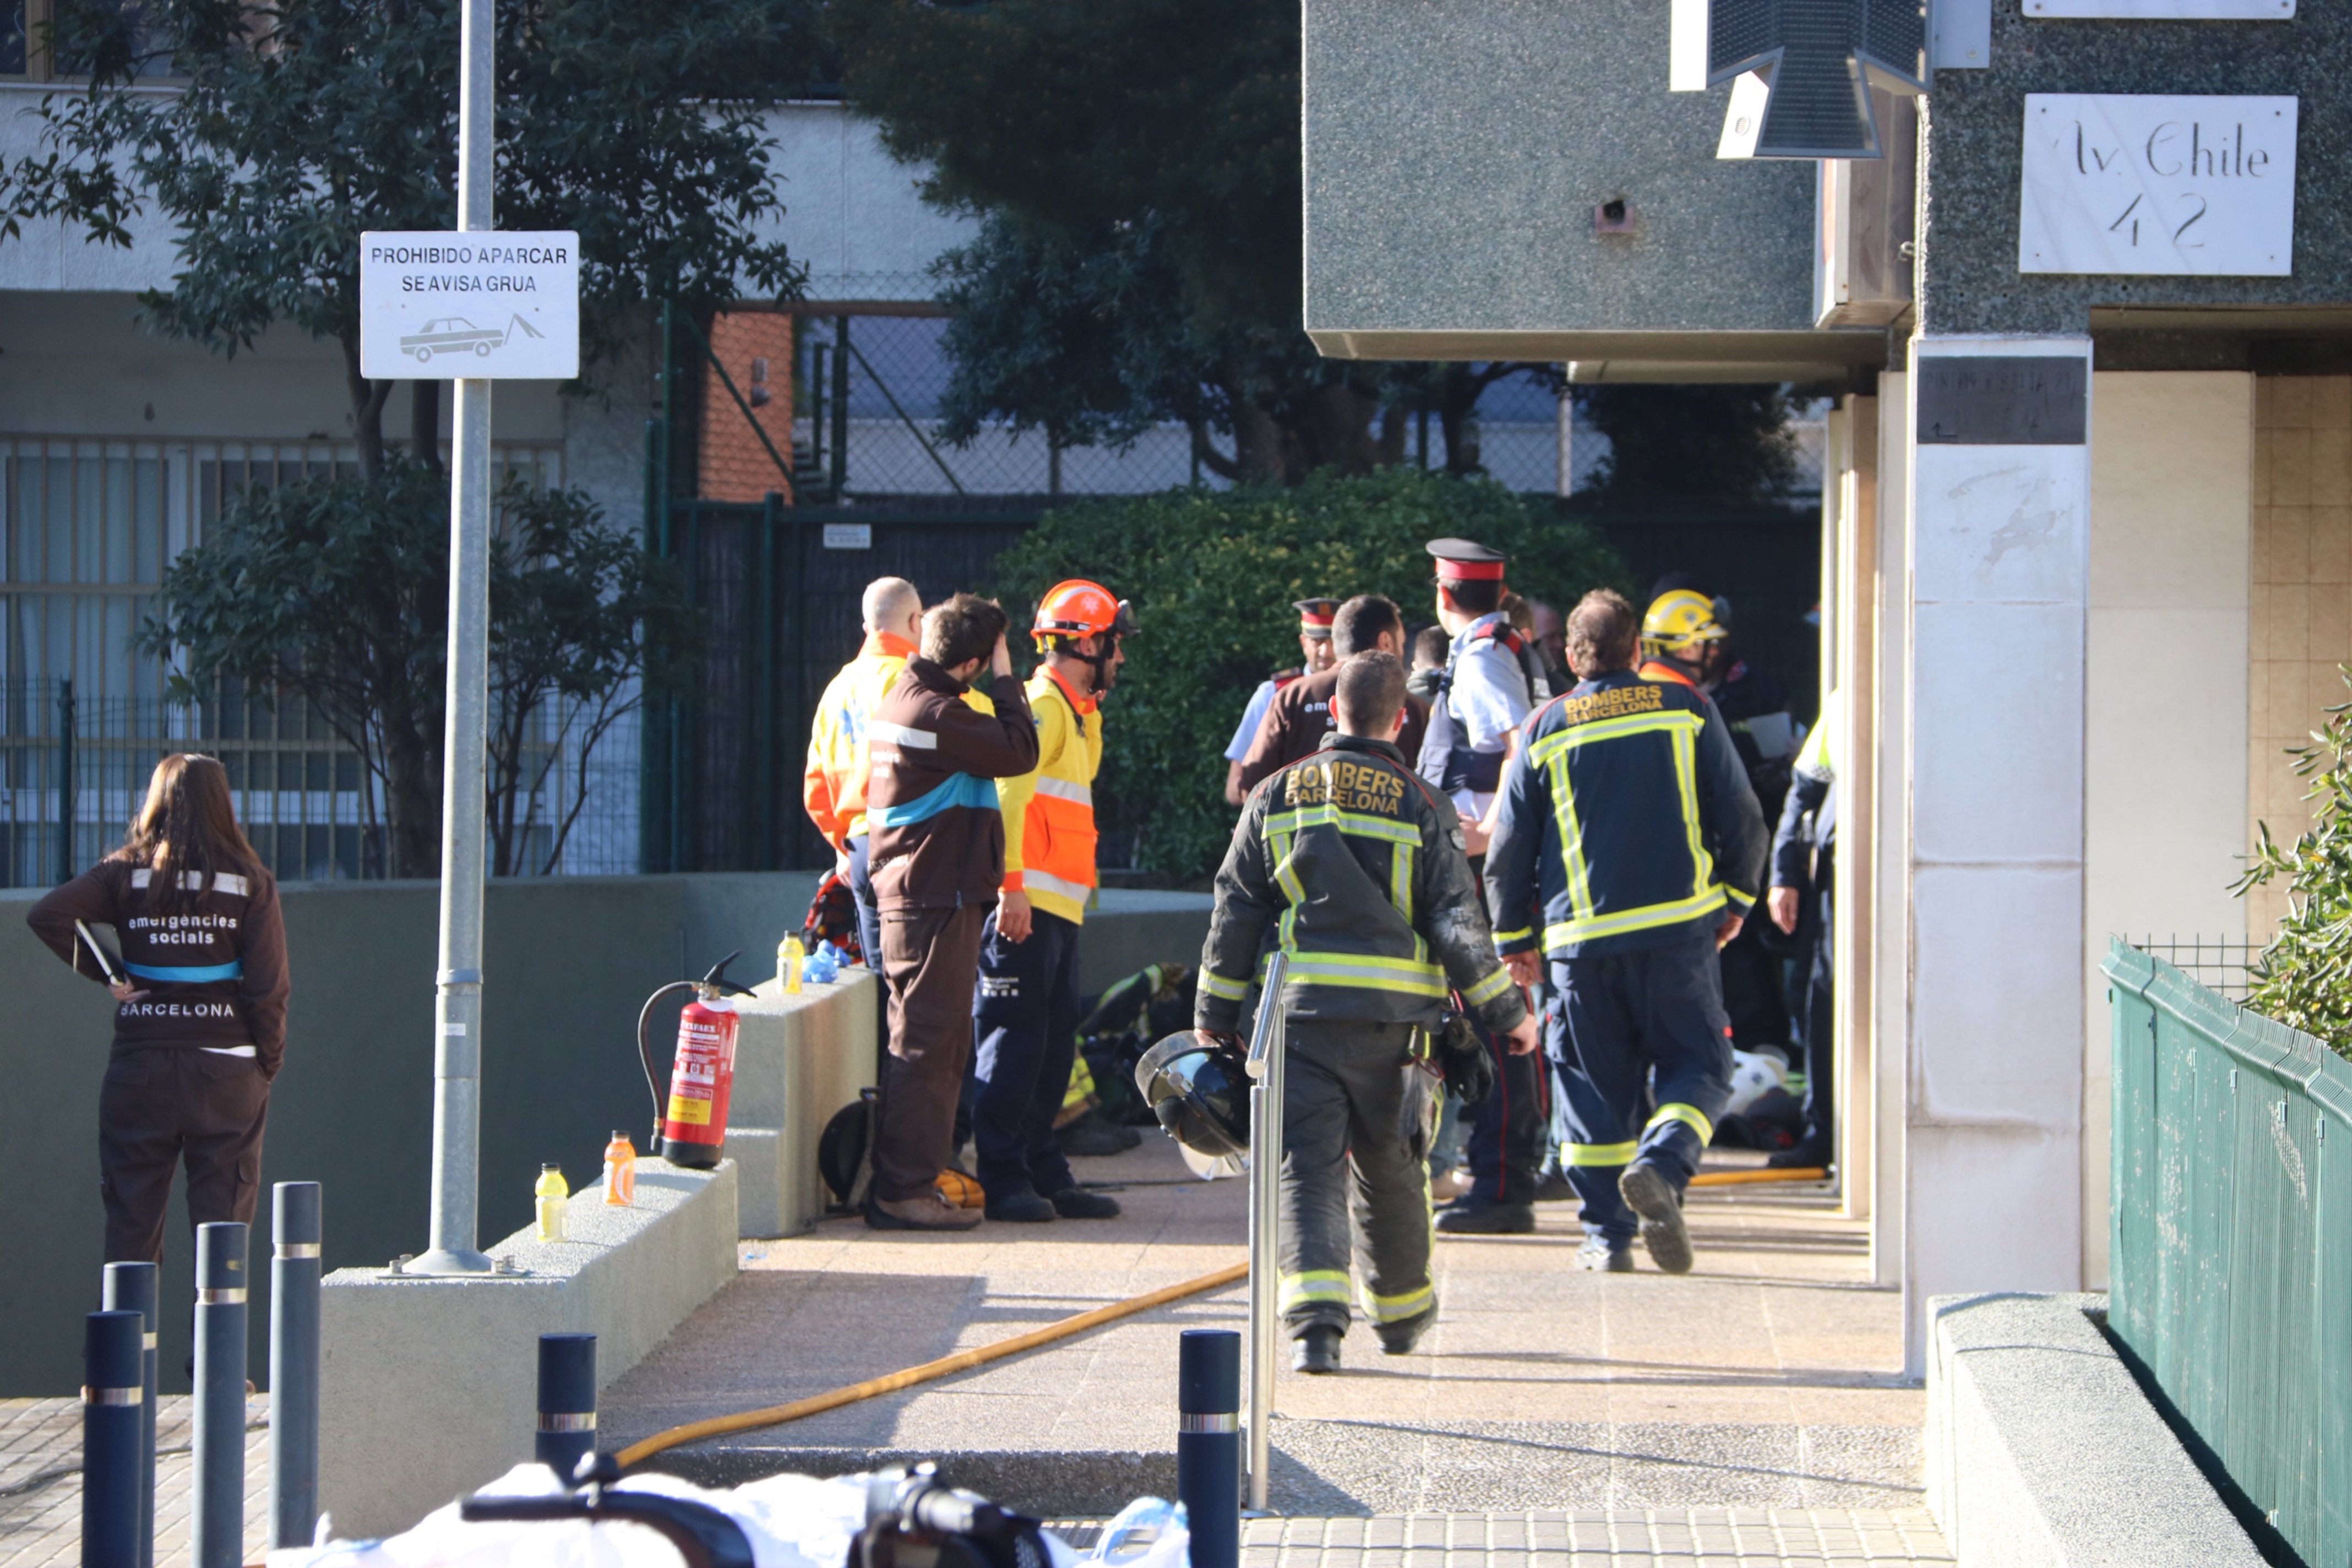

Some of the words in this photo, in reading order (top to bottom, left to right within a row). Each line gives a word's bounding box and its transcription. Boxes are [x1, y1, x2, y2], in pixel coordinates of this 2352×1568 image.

[2146, 121, 2268, 177] Chile
[372, 247, 472, 264] PROHIBIDO
[478, 248, 567, 264] APARCAR
[402, 276, 424, 291] SE
[428, 276, 482, 291] AVISA
[486, 276, 536, 291] GRUA
[1561, 685, 1663, 716] BOMBERS
[1565, 698, 1664, 726] BARCELONA
[1286, 761, 1405, 798] BOMBERS
[1284, 785, 1398, 815] BARCELONA
[128, 913, 238, 929] emergències
[149, 931, 215, 944] socials
[121, 1003, 233, 1016] BARCELONA
